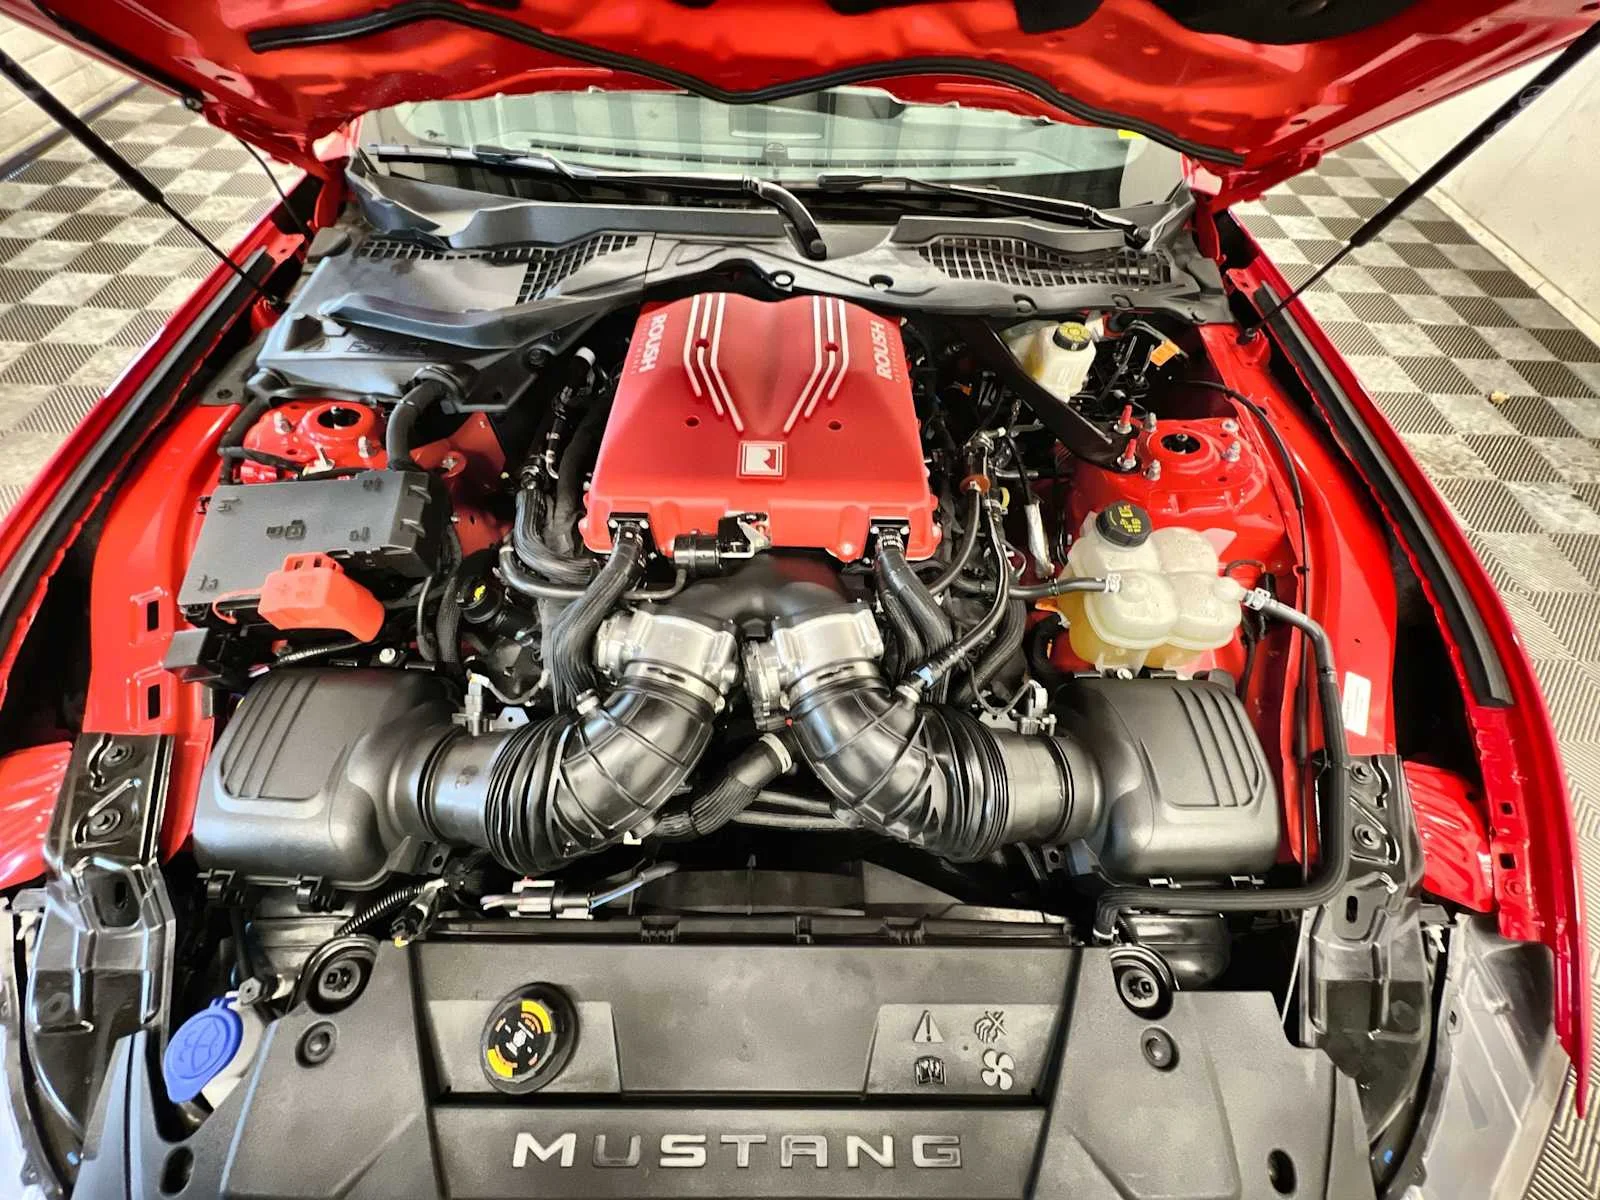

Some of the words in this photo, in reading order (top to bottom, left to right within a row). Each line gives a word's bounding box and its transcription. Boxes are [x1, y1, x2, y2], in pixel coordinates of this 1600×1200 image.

[639, 313, 668, 373] ROUSH
[870, 320, 893, 380] ROUSH
[512, 1132, 962, 1169] MUSTANG
